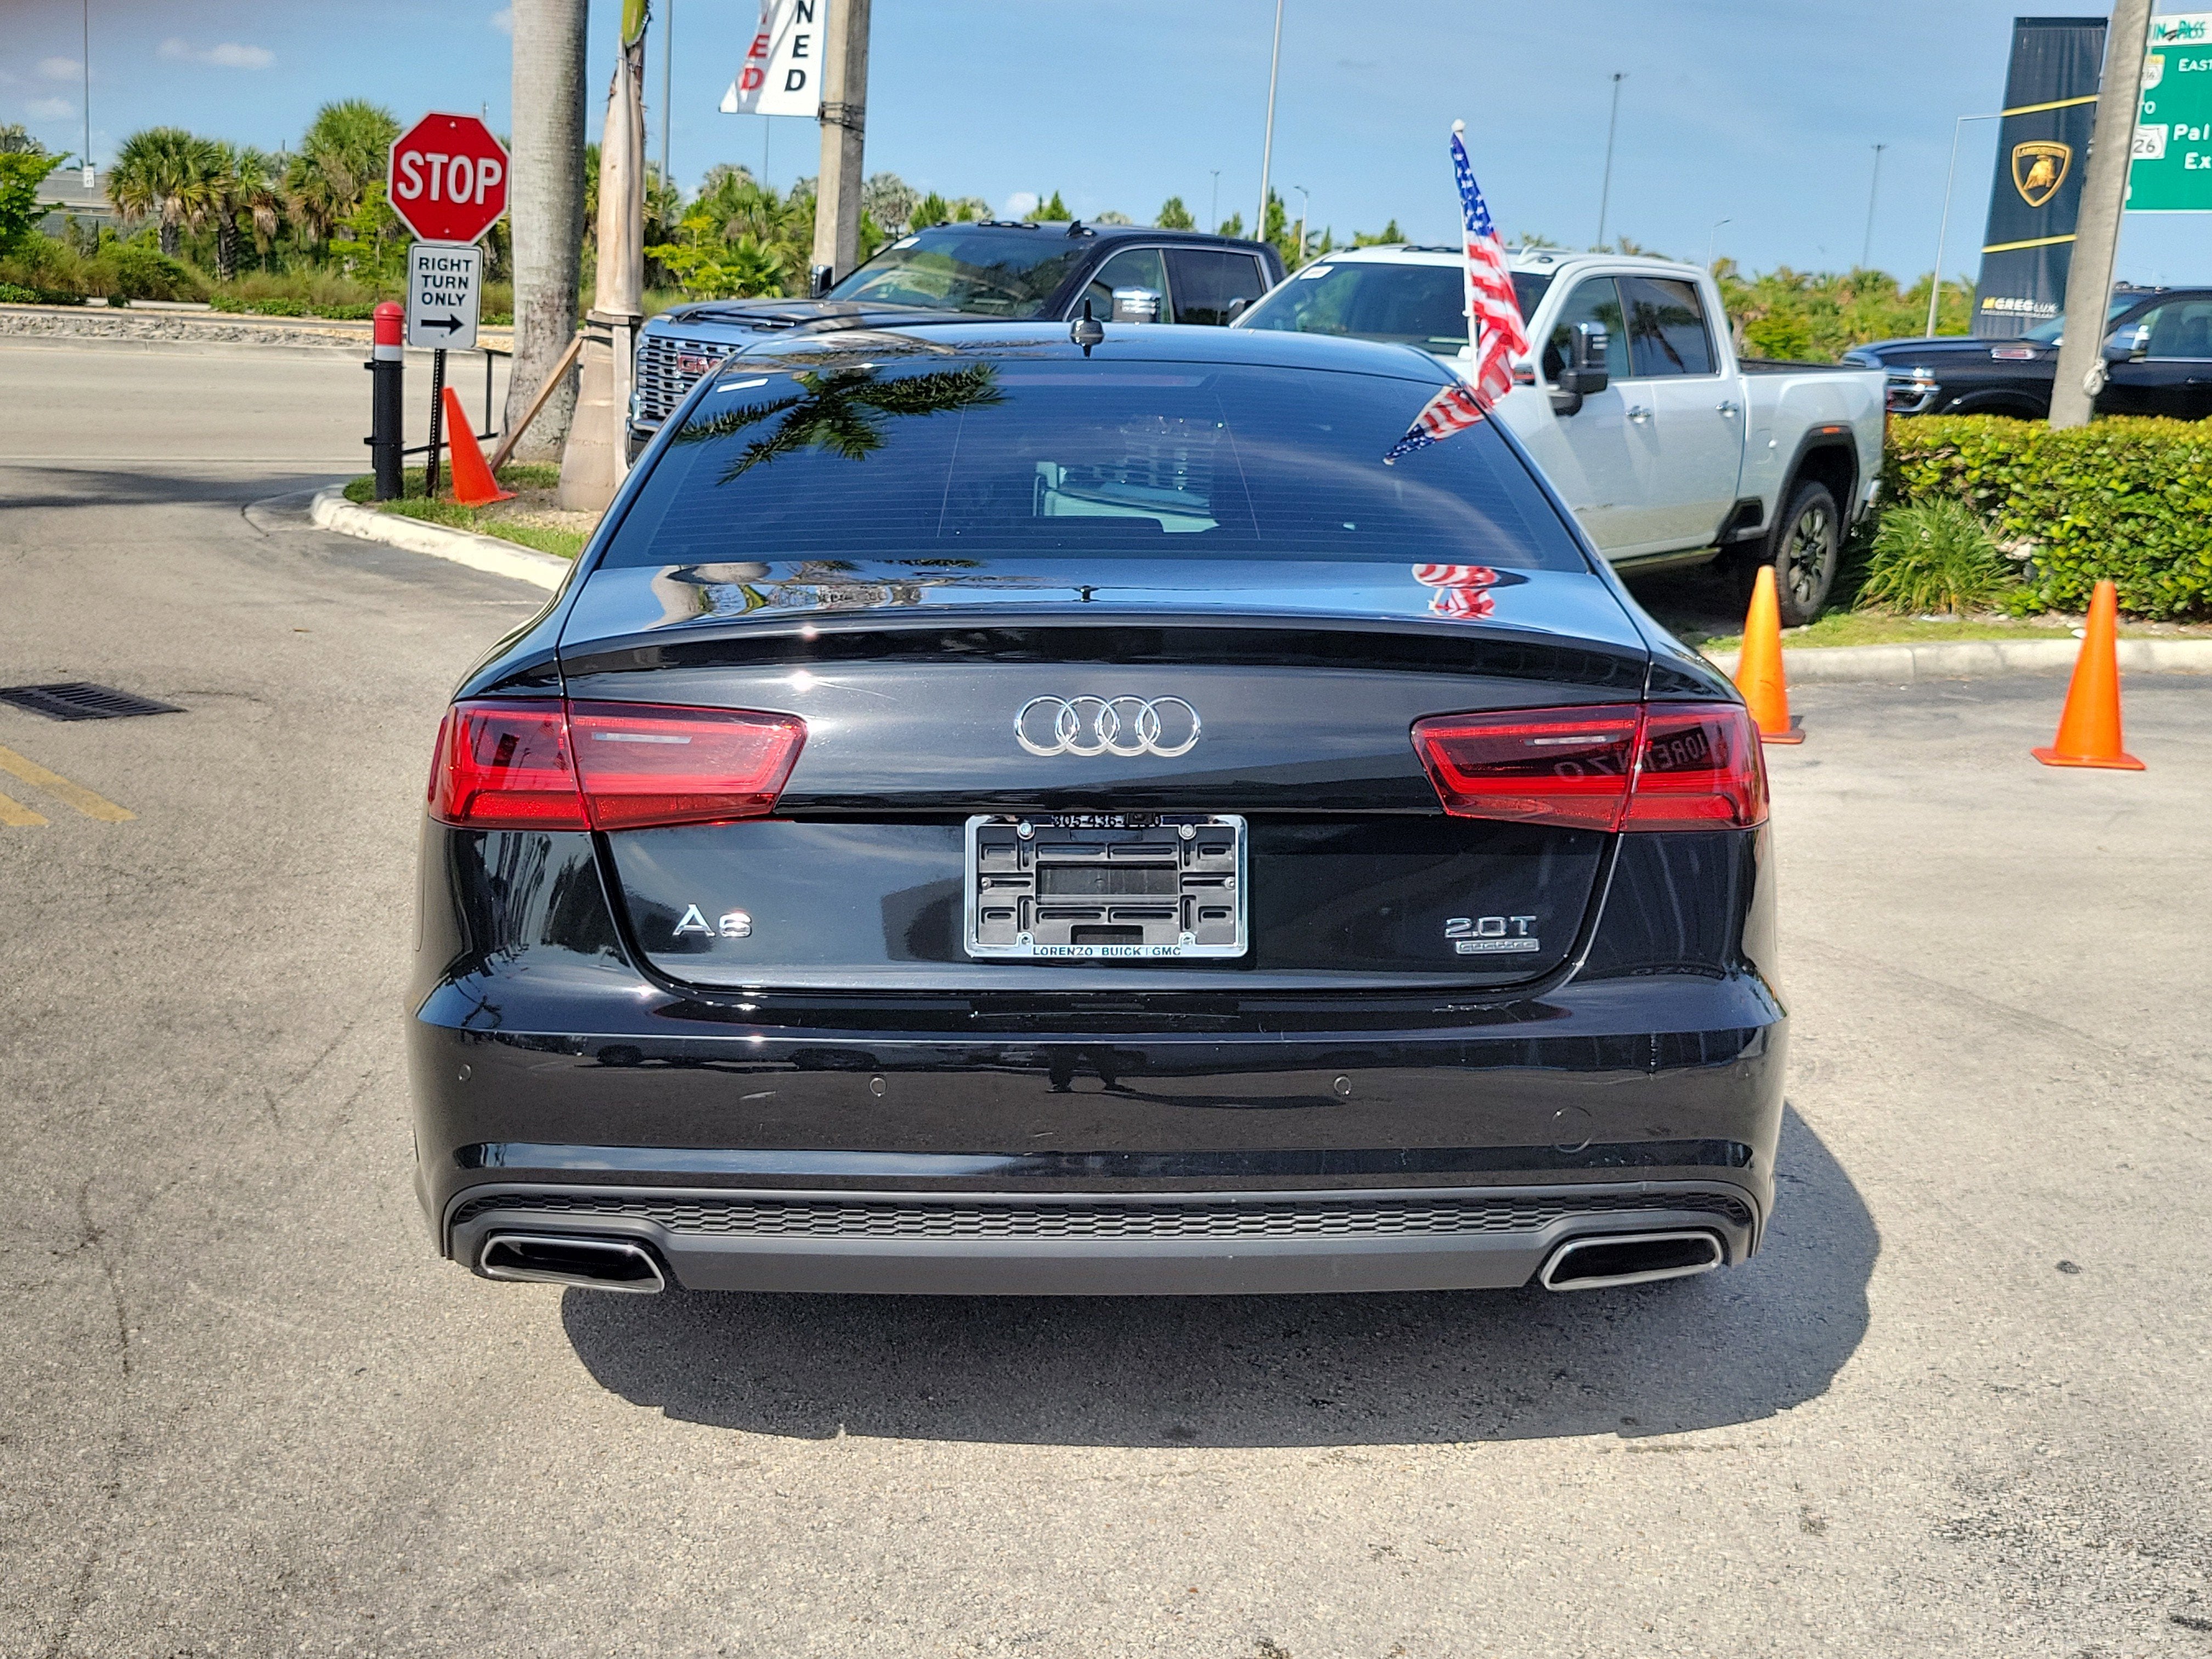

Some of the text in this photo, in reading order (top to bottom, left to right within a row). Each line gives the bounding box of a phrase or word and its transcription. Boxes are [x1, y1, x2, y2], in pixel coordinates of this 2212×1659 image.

[397, 150, 503, 205] STOP
[419, 257, 473, 273] RIGHT
[421, 274, 469, 289] TURN
[421, 292, 467, 307] ONLY
[672, 904, 752, 938] A6
[1445, 915, 1536, 938] 2.0T
[1033, 947, 1181, 956] LORENZO BUICK GMC
